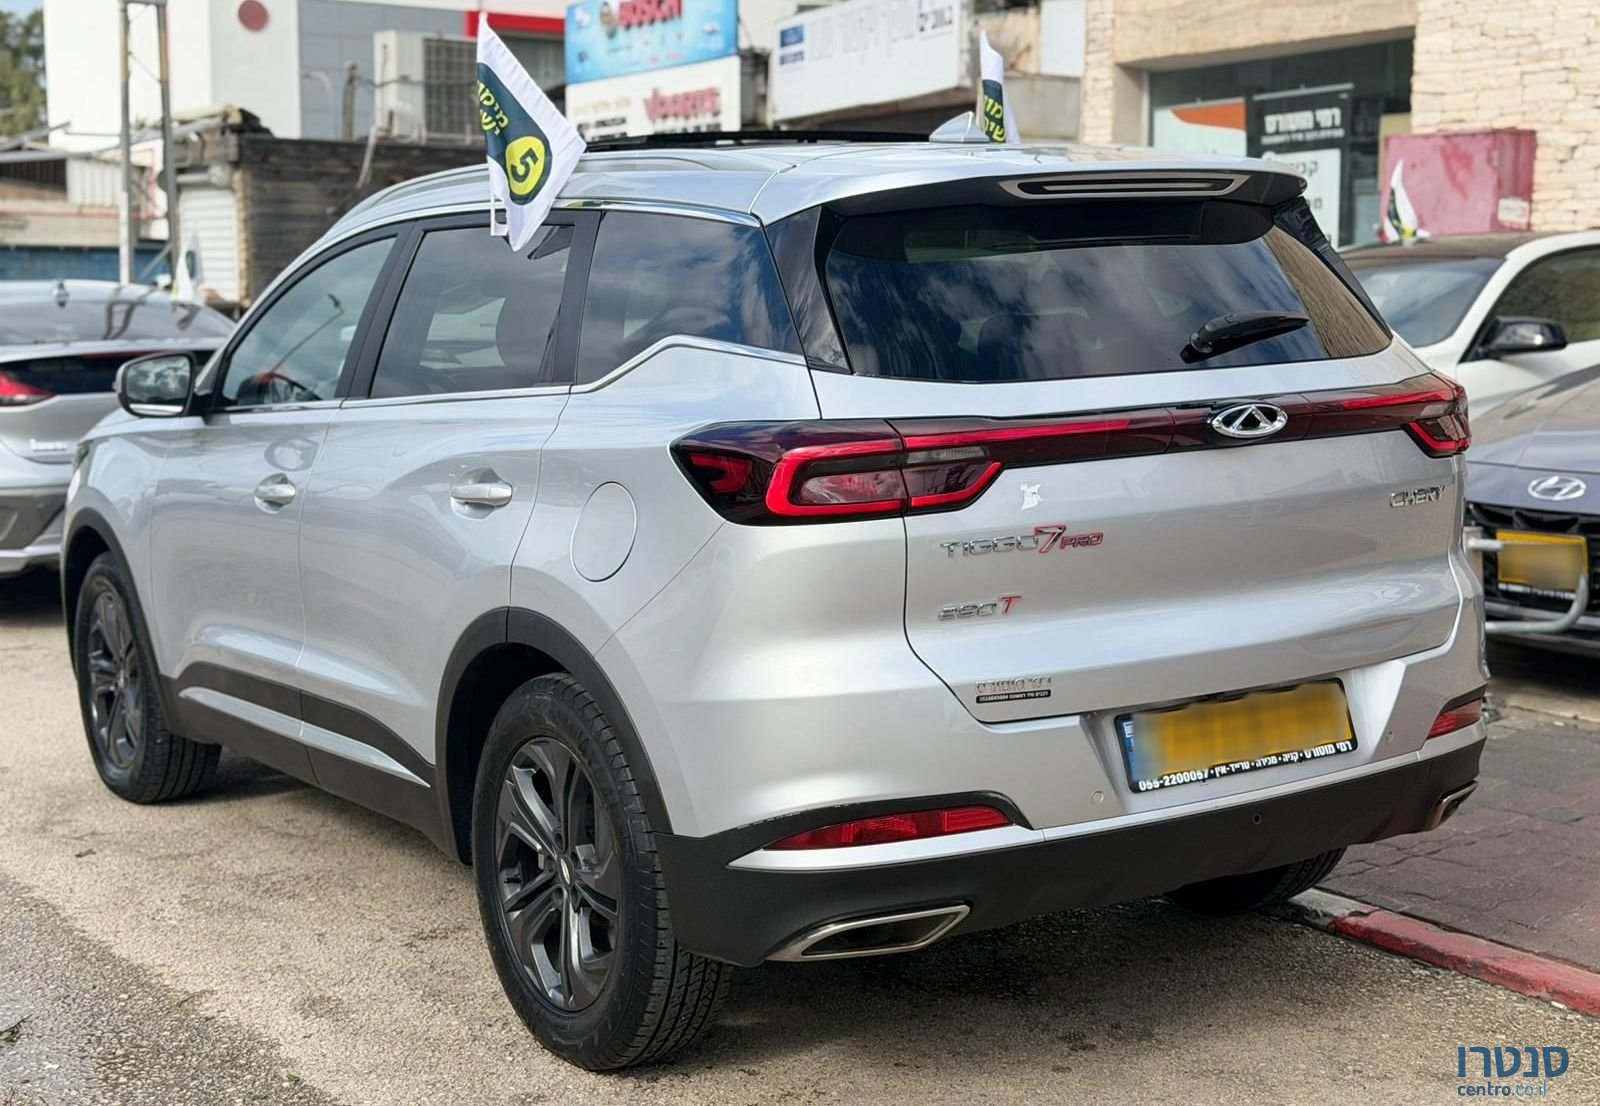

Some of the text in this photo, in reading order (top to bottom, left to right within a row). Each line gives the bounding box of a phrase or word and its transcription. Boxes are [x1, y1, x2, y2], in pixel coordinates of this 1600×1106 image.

[510, 148, 539, 184] 5
[1390, 485, 1447, 508] CHERY
[1336, 740, 1353, 752] רמי
[1281, 751, 1300, 763] קניה
